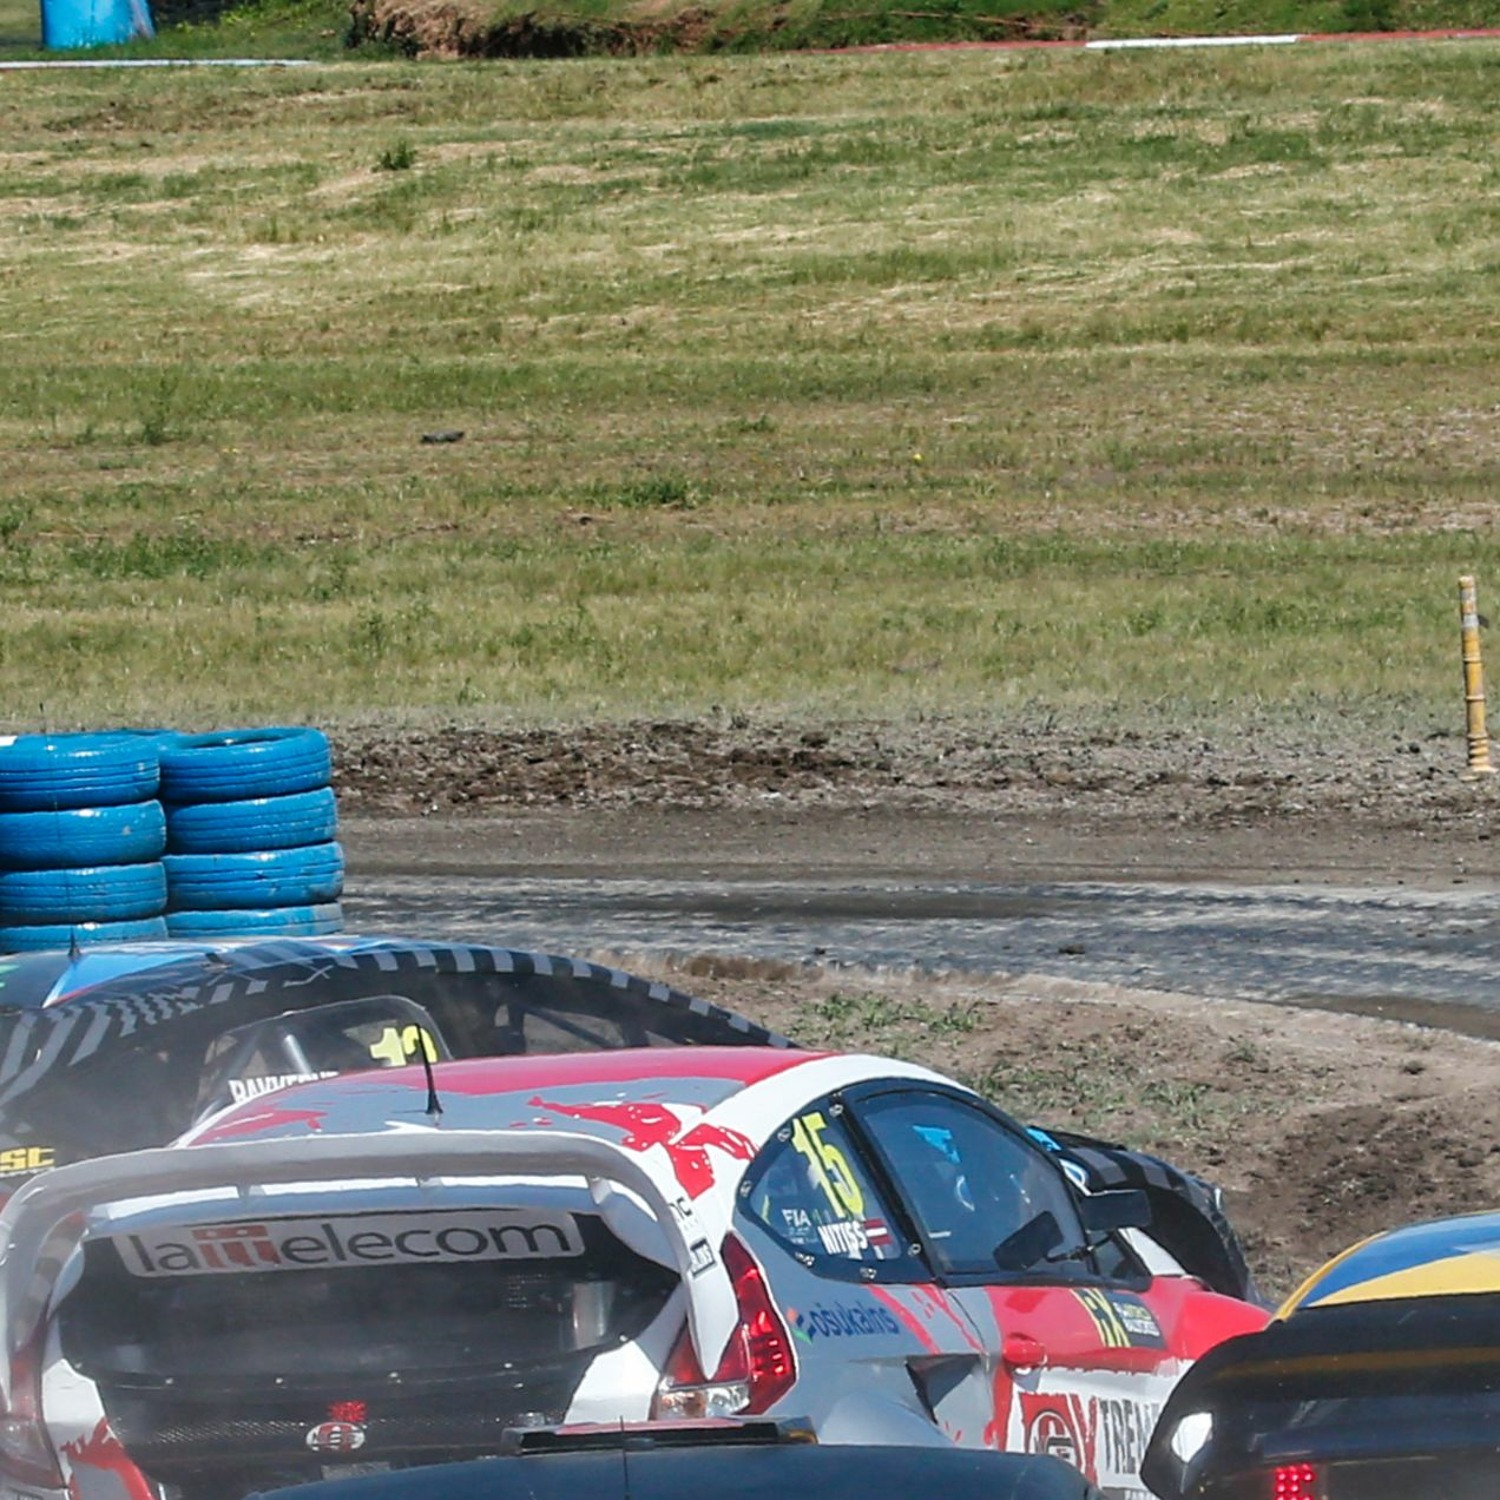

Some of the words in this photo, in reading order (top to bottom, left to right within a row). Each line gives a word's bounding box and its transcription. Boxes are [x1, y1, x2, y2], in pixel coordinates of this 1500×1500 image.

[791, 1112, 864, 1218] 15
[782, 1209, 811, 1227] FIA
[817, 1220, 868, 1255] NITISS
